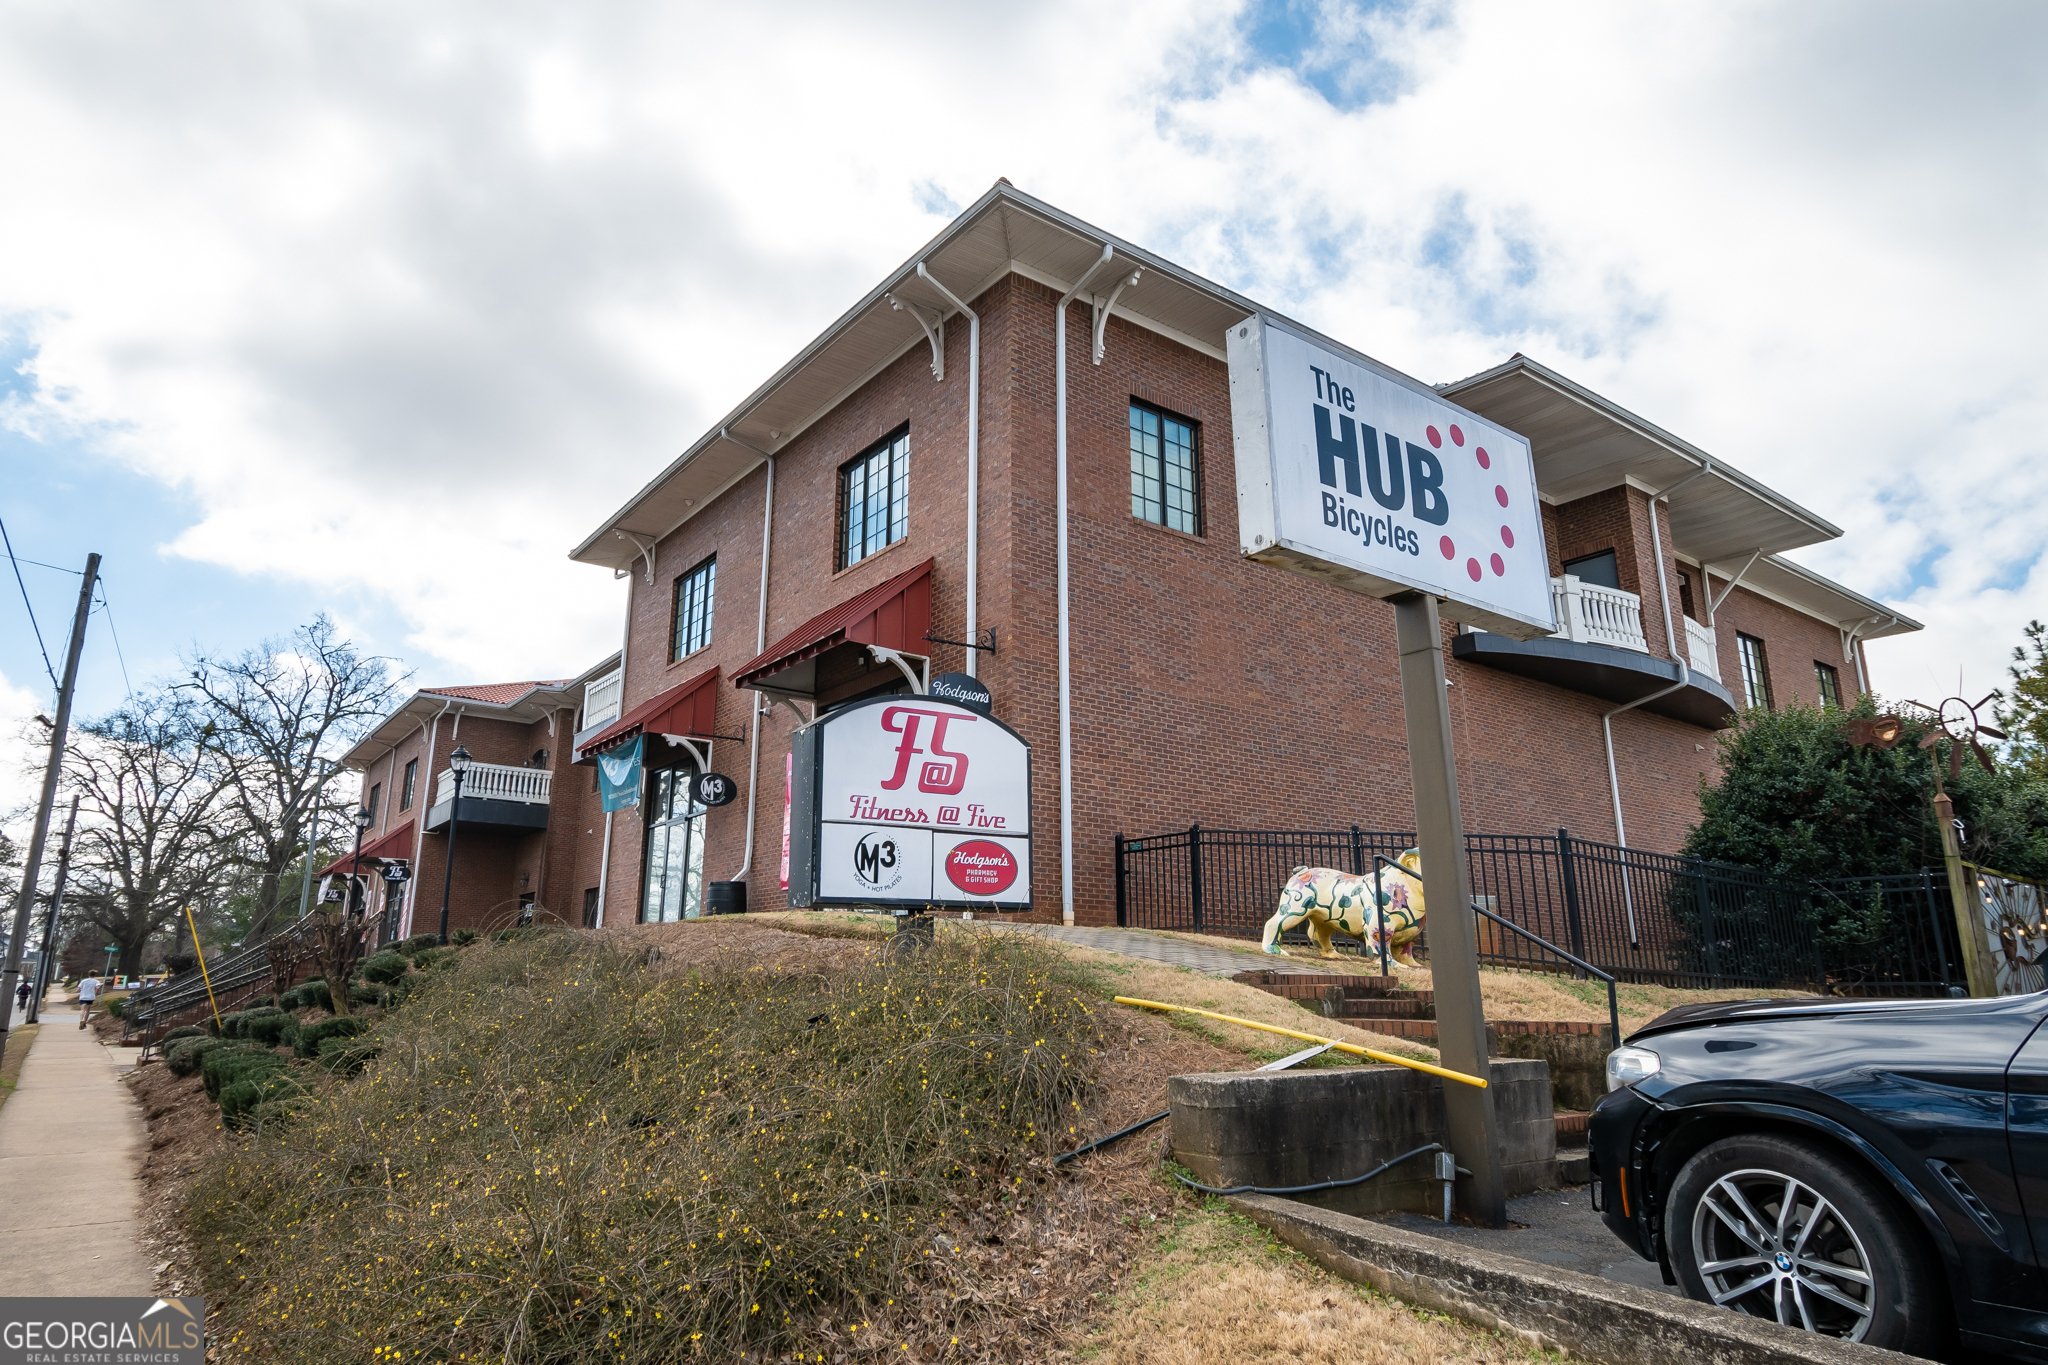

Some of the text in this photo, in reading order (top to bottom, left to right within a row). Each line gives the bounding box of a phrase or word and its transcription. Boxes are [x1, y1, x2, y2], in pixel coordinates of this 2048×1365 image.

[1309, 365, 1356, 413] The
[1313, 403, 1449, 526] HUB
[1321, 491, 1420, 557] Bicycles
[932, 681, 990, 703] Hodgson's
[703, 779, 723, 801] M3
[849, 795, 1006, 829] Fitness @ Five
[860, 840, 896, 884] M3
[953, 851, 1010, 868] Hodgson's
[853, 872, 866, 888] YOGA
[871, 885, 883, 893] HOT
[884, 875, 903, 891] PILATES
